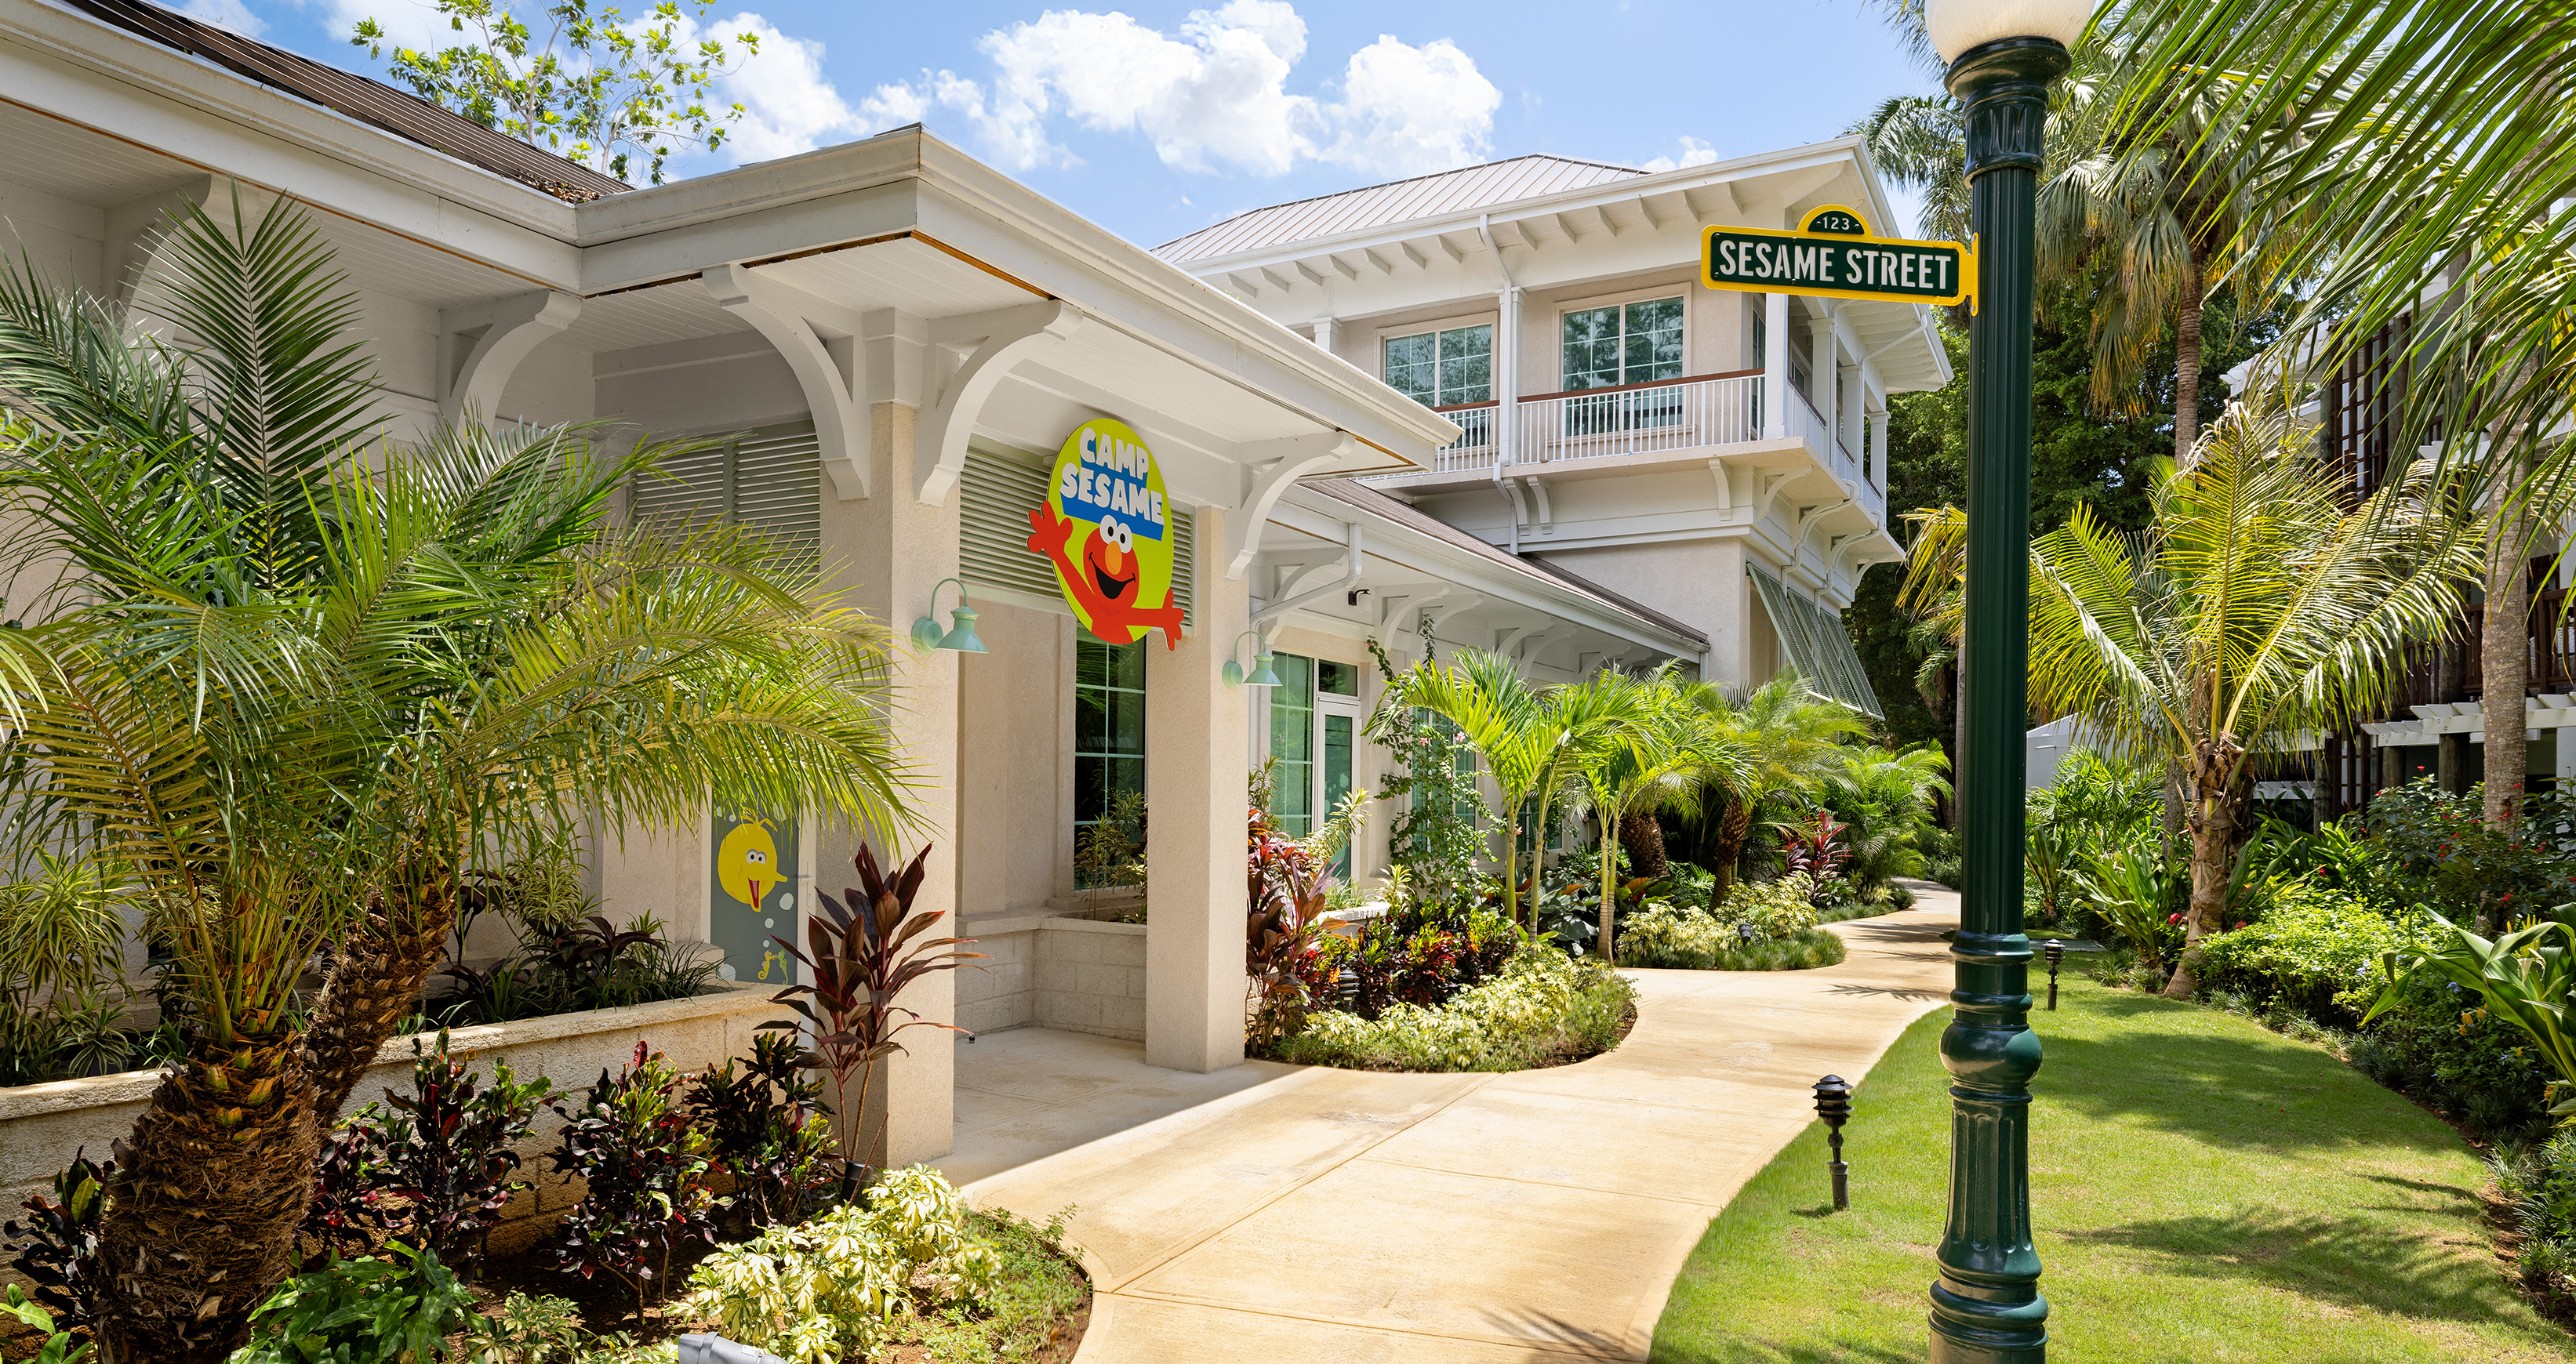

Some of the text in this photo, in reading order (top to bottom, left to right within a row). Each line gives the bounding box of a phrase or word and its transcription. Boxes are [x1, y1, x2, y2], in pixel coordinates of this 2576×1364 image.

[1822, 216, 1850, 230] 123
[1719, 240, 1951, 289] SESAME STREET
[1079, 427, 1149, 481] CAMP
[1059, 463, 1164, 525] SESAME
